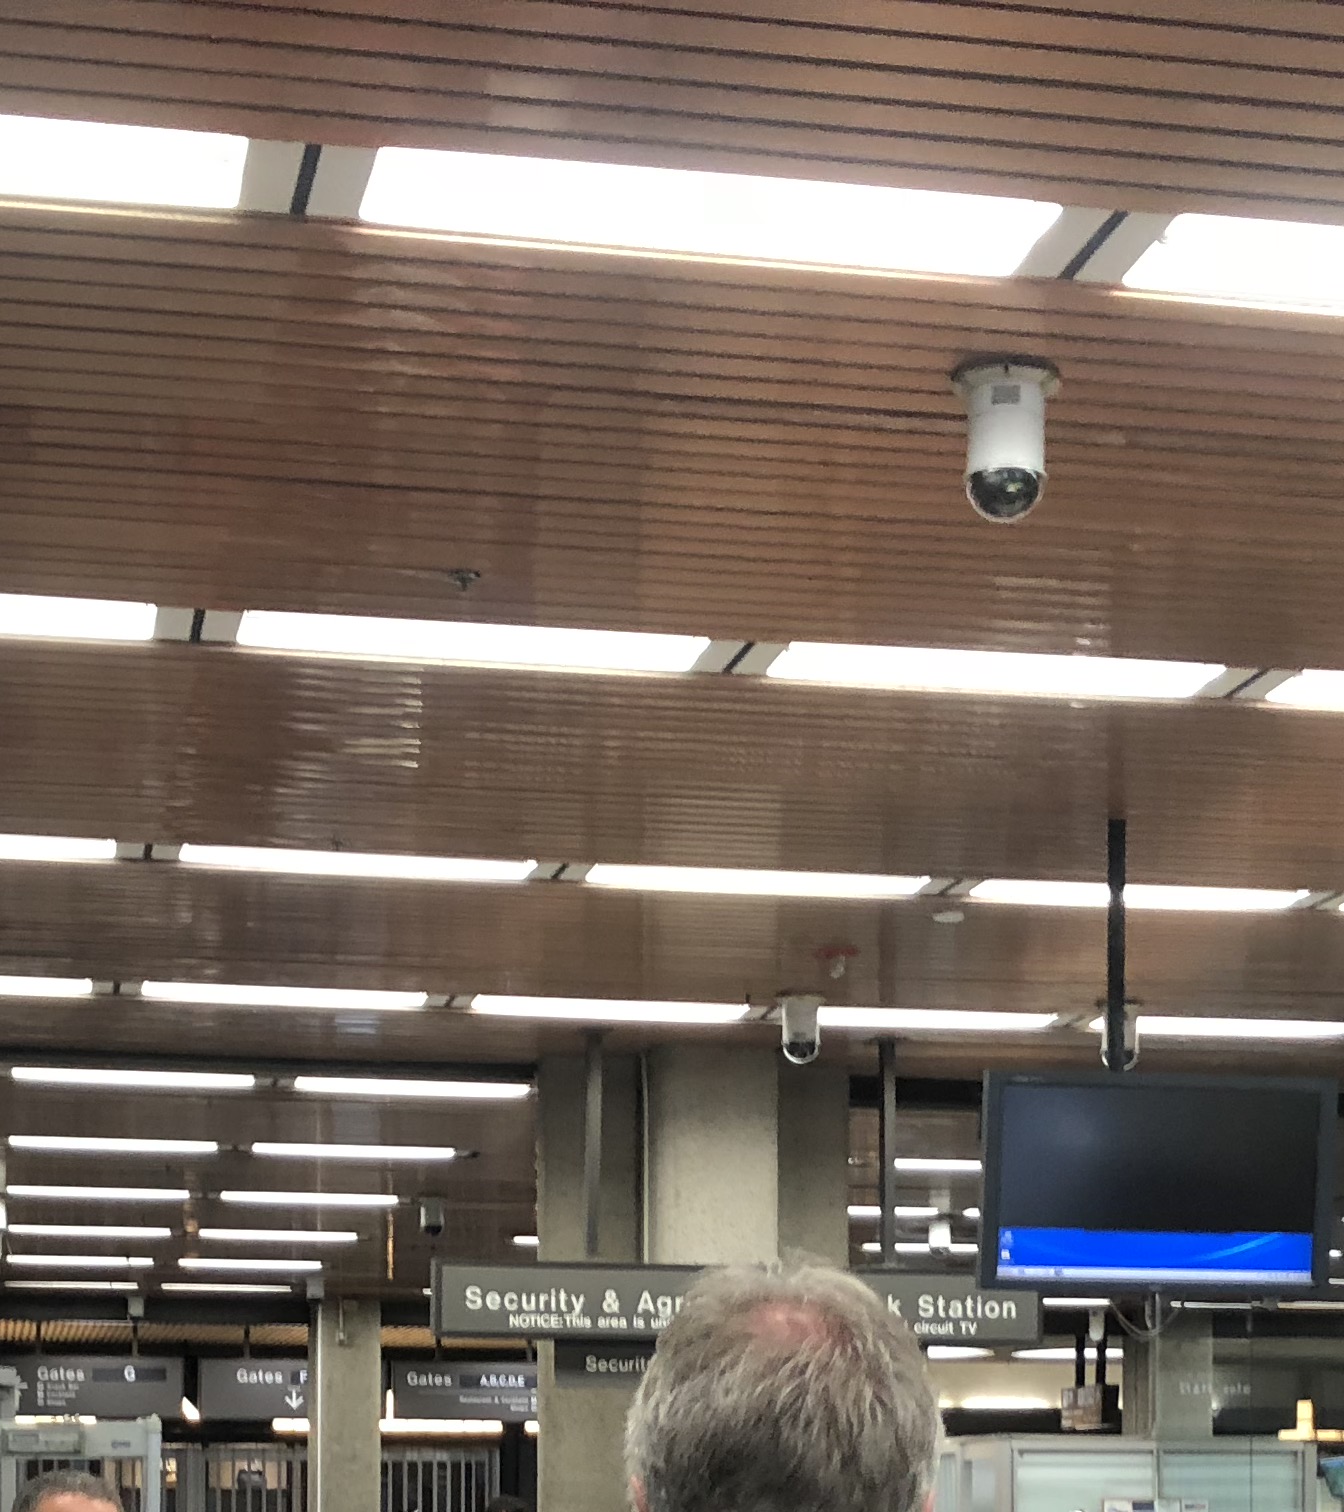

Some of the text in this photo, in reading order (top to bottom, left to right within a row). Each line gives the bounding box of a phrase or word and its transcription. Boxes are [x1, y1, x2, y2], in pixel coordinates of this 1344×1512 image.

[465, 1285, 585, 1315] Security
[602, 1288, 620, 1314] &
[918, 1294, 1017, 1319] Station
[565, 1314, 592, 1328] This
[597, 1314, 627, 1329] area
[633, 1314, 645, 1328] is
[914, 1320, 955, 1336] circuit
[959, 1321, 978, 1336] TV
[585, 1354, 649, 1374] Securit
[37, 1365, 85, 1383] Gates
[236, 1368, 283, 1385] Gates
[407, 1371, 452, 1387] Gates
